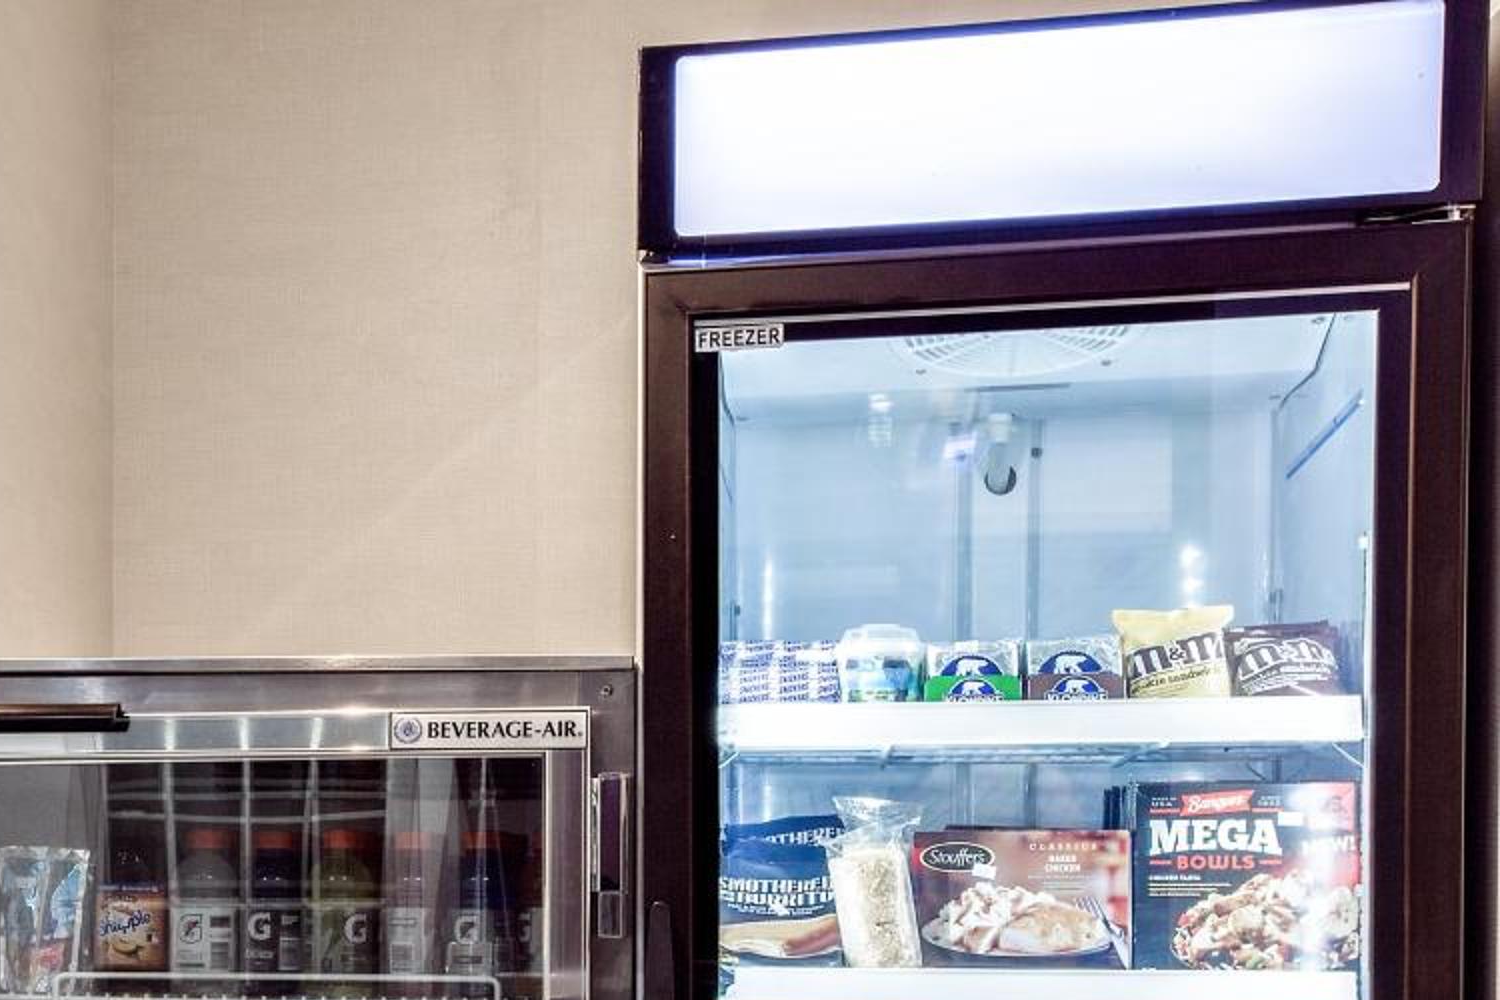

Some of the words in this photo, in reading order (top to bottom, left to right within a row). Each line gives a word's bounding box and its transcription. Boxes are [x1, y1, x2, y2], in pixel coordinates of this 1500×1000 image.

[698, 327, 780, 348] FREEZER
[426, 718, 577, 739] BEVERAGE-AIR
[1148, 818, 1283, 857] MEGA
[928, 849, 987, 867] Stouffer's
[1176, 855, 1256, 871] BOWLS
